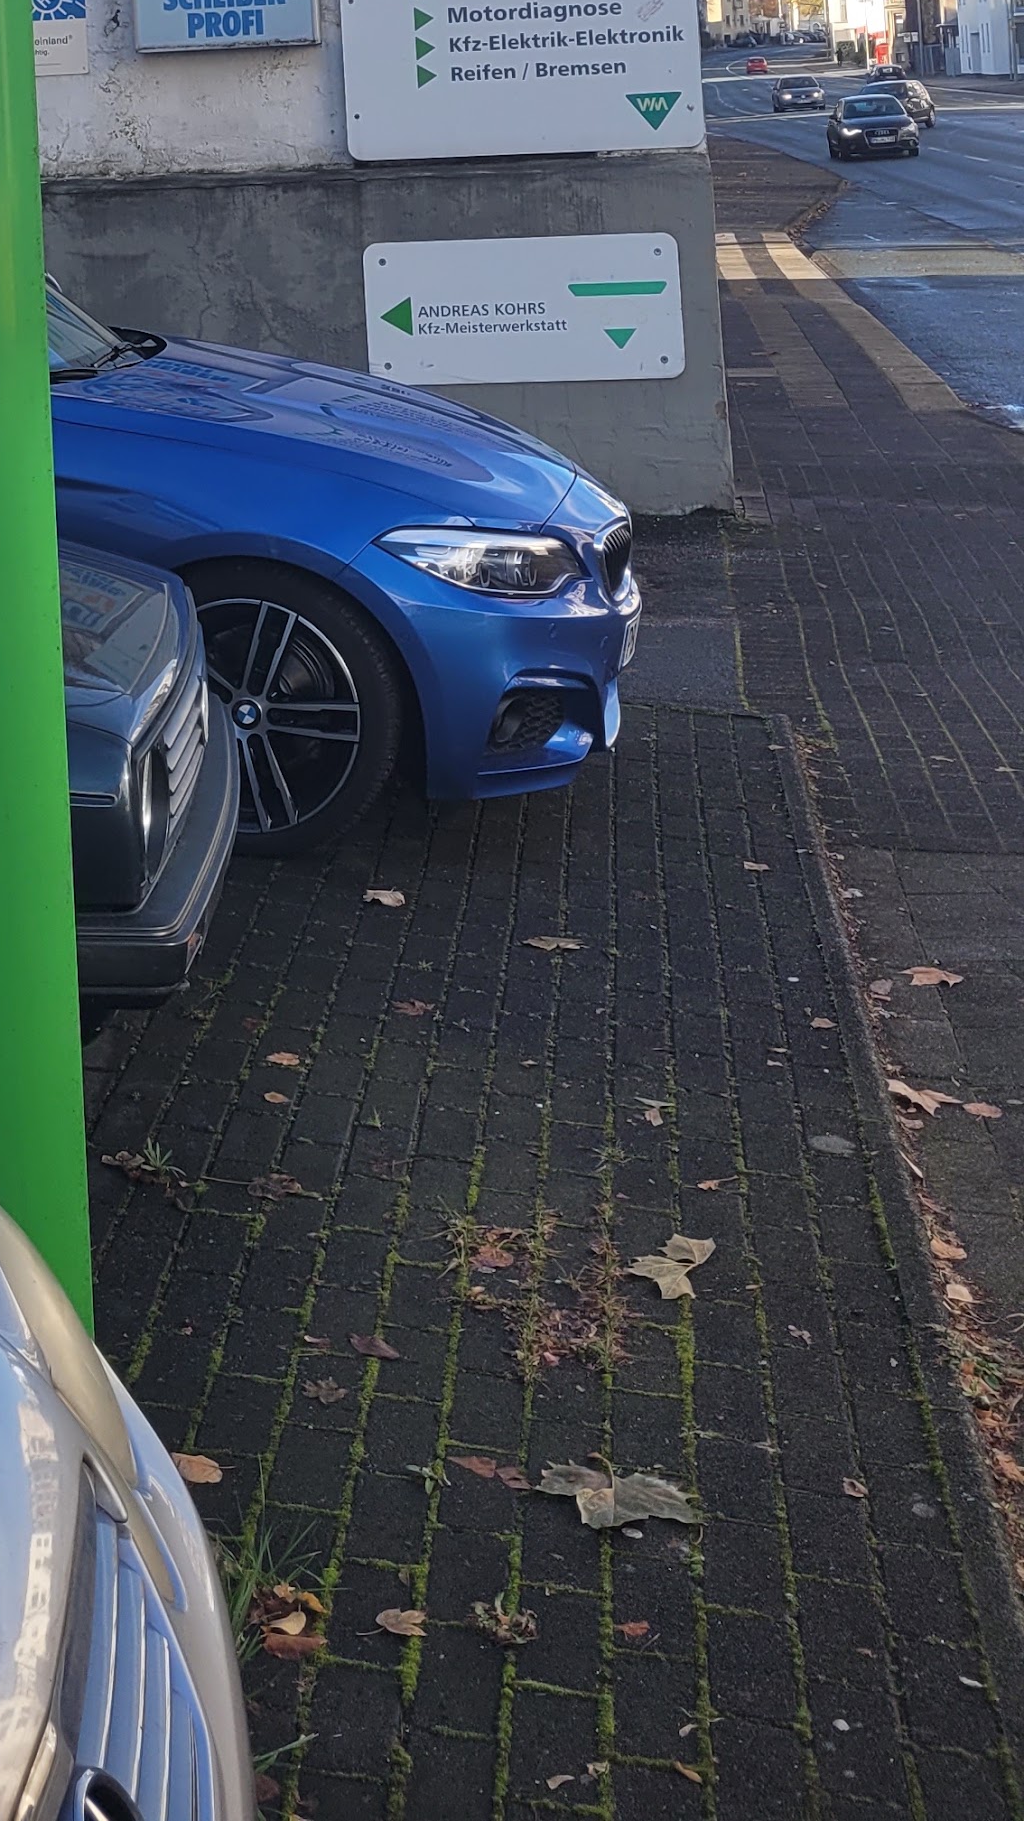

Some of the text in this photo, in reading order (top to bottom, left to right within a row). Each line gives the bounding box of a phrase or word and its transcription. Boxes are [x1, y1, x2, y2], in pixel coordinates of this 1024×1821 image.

[187, 9, 264, 38] PROFI
[447, 0, 622, 24] Motordiagnose
[449, 25, 684, 53] Kfz-Elektrik-Elektronik
[450, 59, 627, 82] Reifen / Bremsen
[417, 302, 546, 318] ANDREAS KOHRS
[418, 319, 568, 335] Kfz-Meisterwerkstatt
